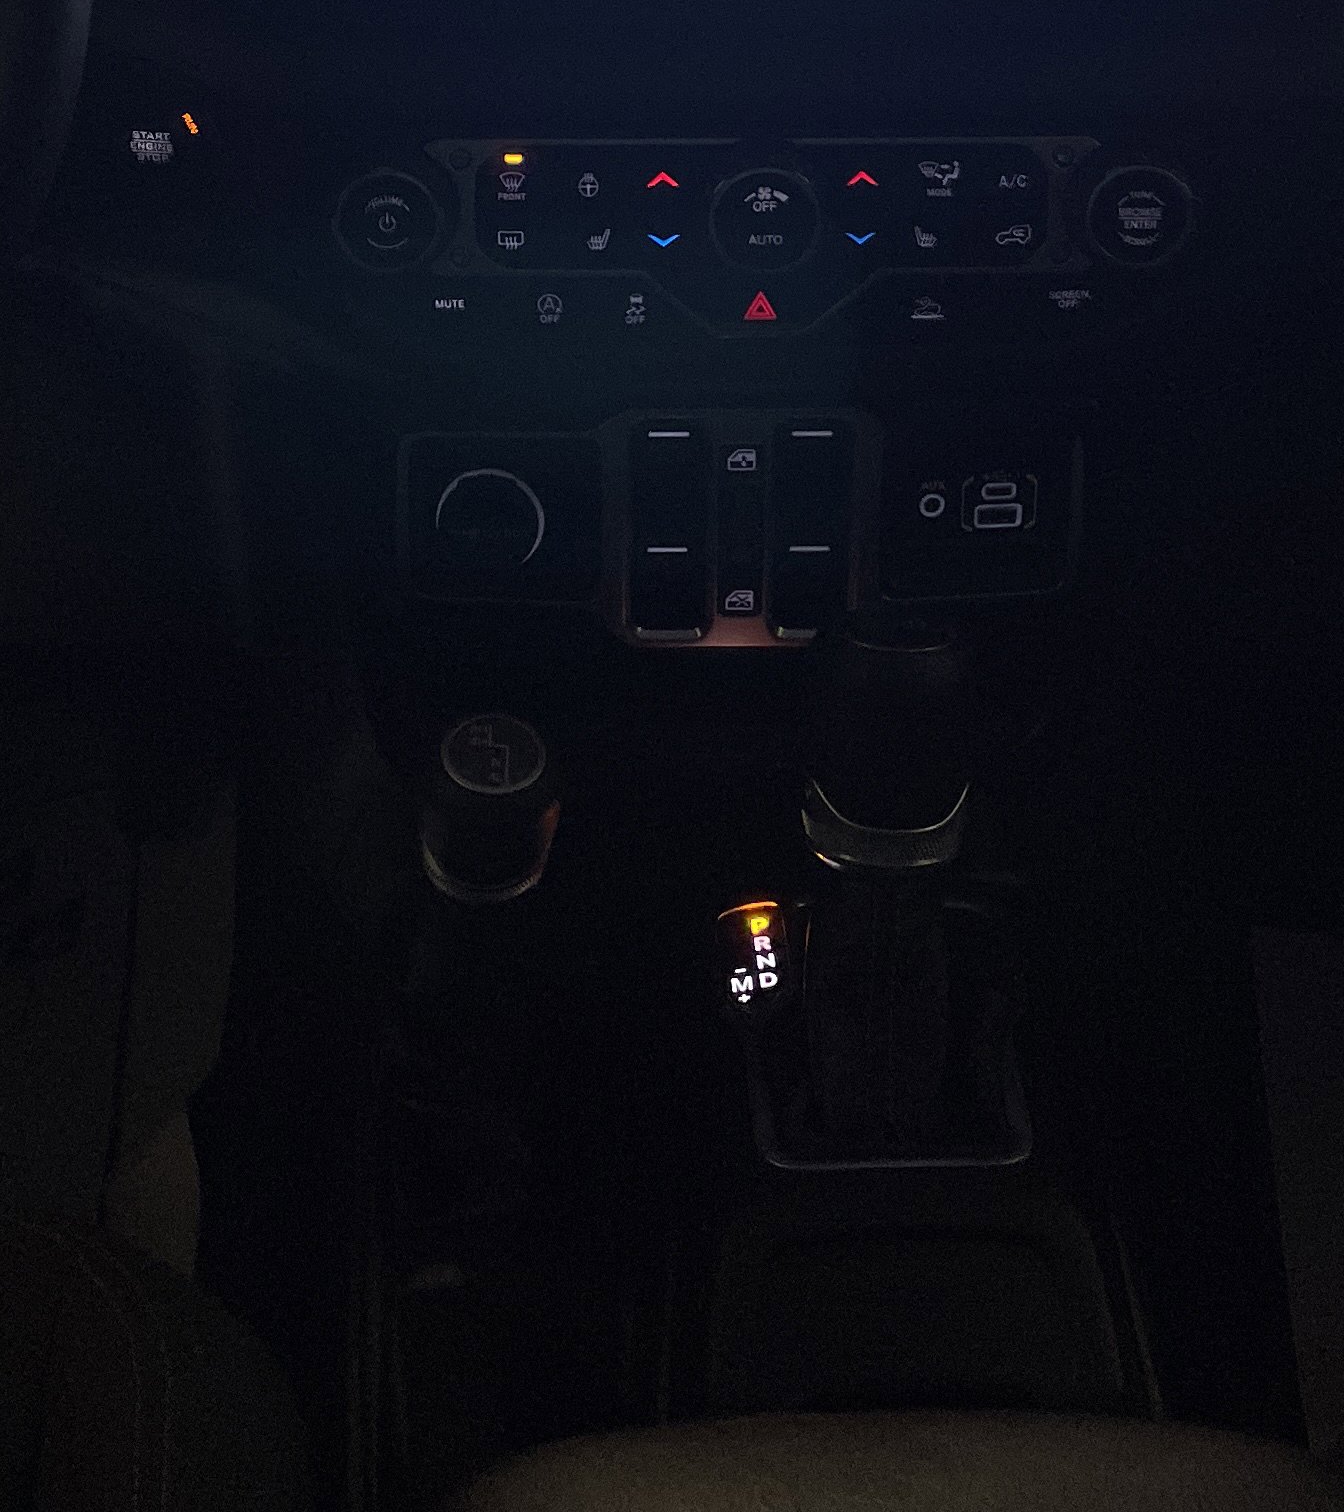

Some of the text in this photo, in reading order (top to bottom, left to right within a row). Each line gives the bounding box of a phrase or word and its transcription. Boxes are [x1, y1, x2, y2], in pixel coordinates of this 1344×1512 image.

[131, 131, 171, 140] START
[999, 174, 1028, 188] A/C
[497, 192, 527, 201] FRONT
[752, 200, 778, 212] OFF
[748, 234, 783, 245] AUTO
[435, 299, 465, 310] MUTE
[539, 314, 560, 324] OFF
[753, 935, 772, 952] R
[756, 952, 776, 969] N
[731, 976, 754, 993] M
[758, 972, 778, 988] D
